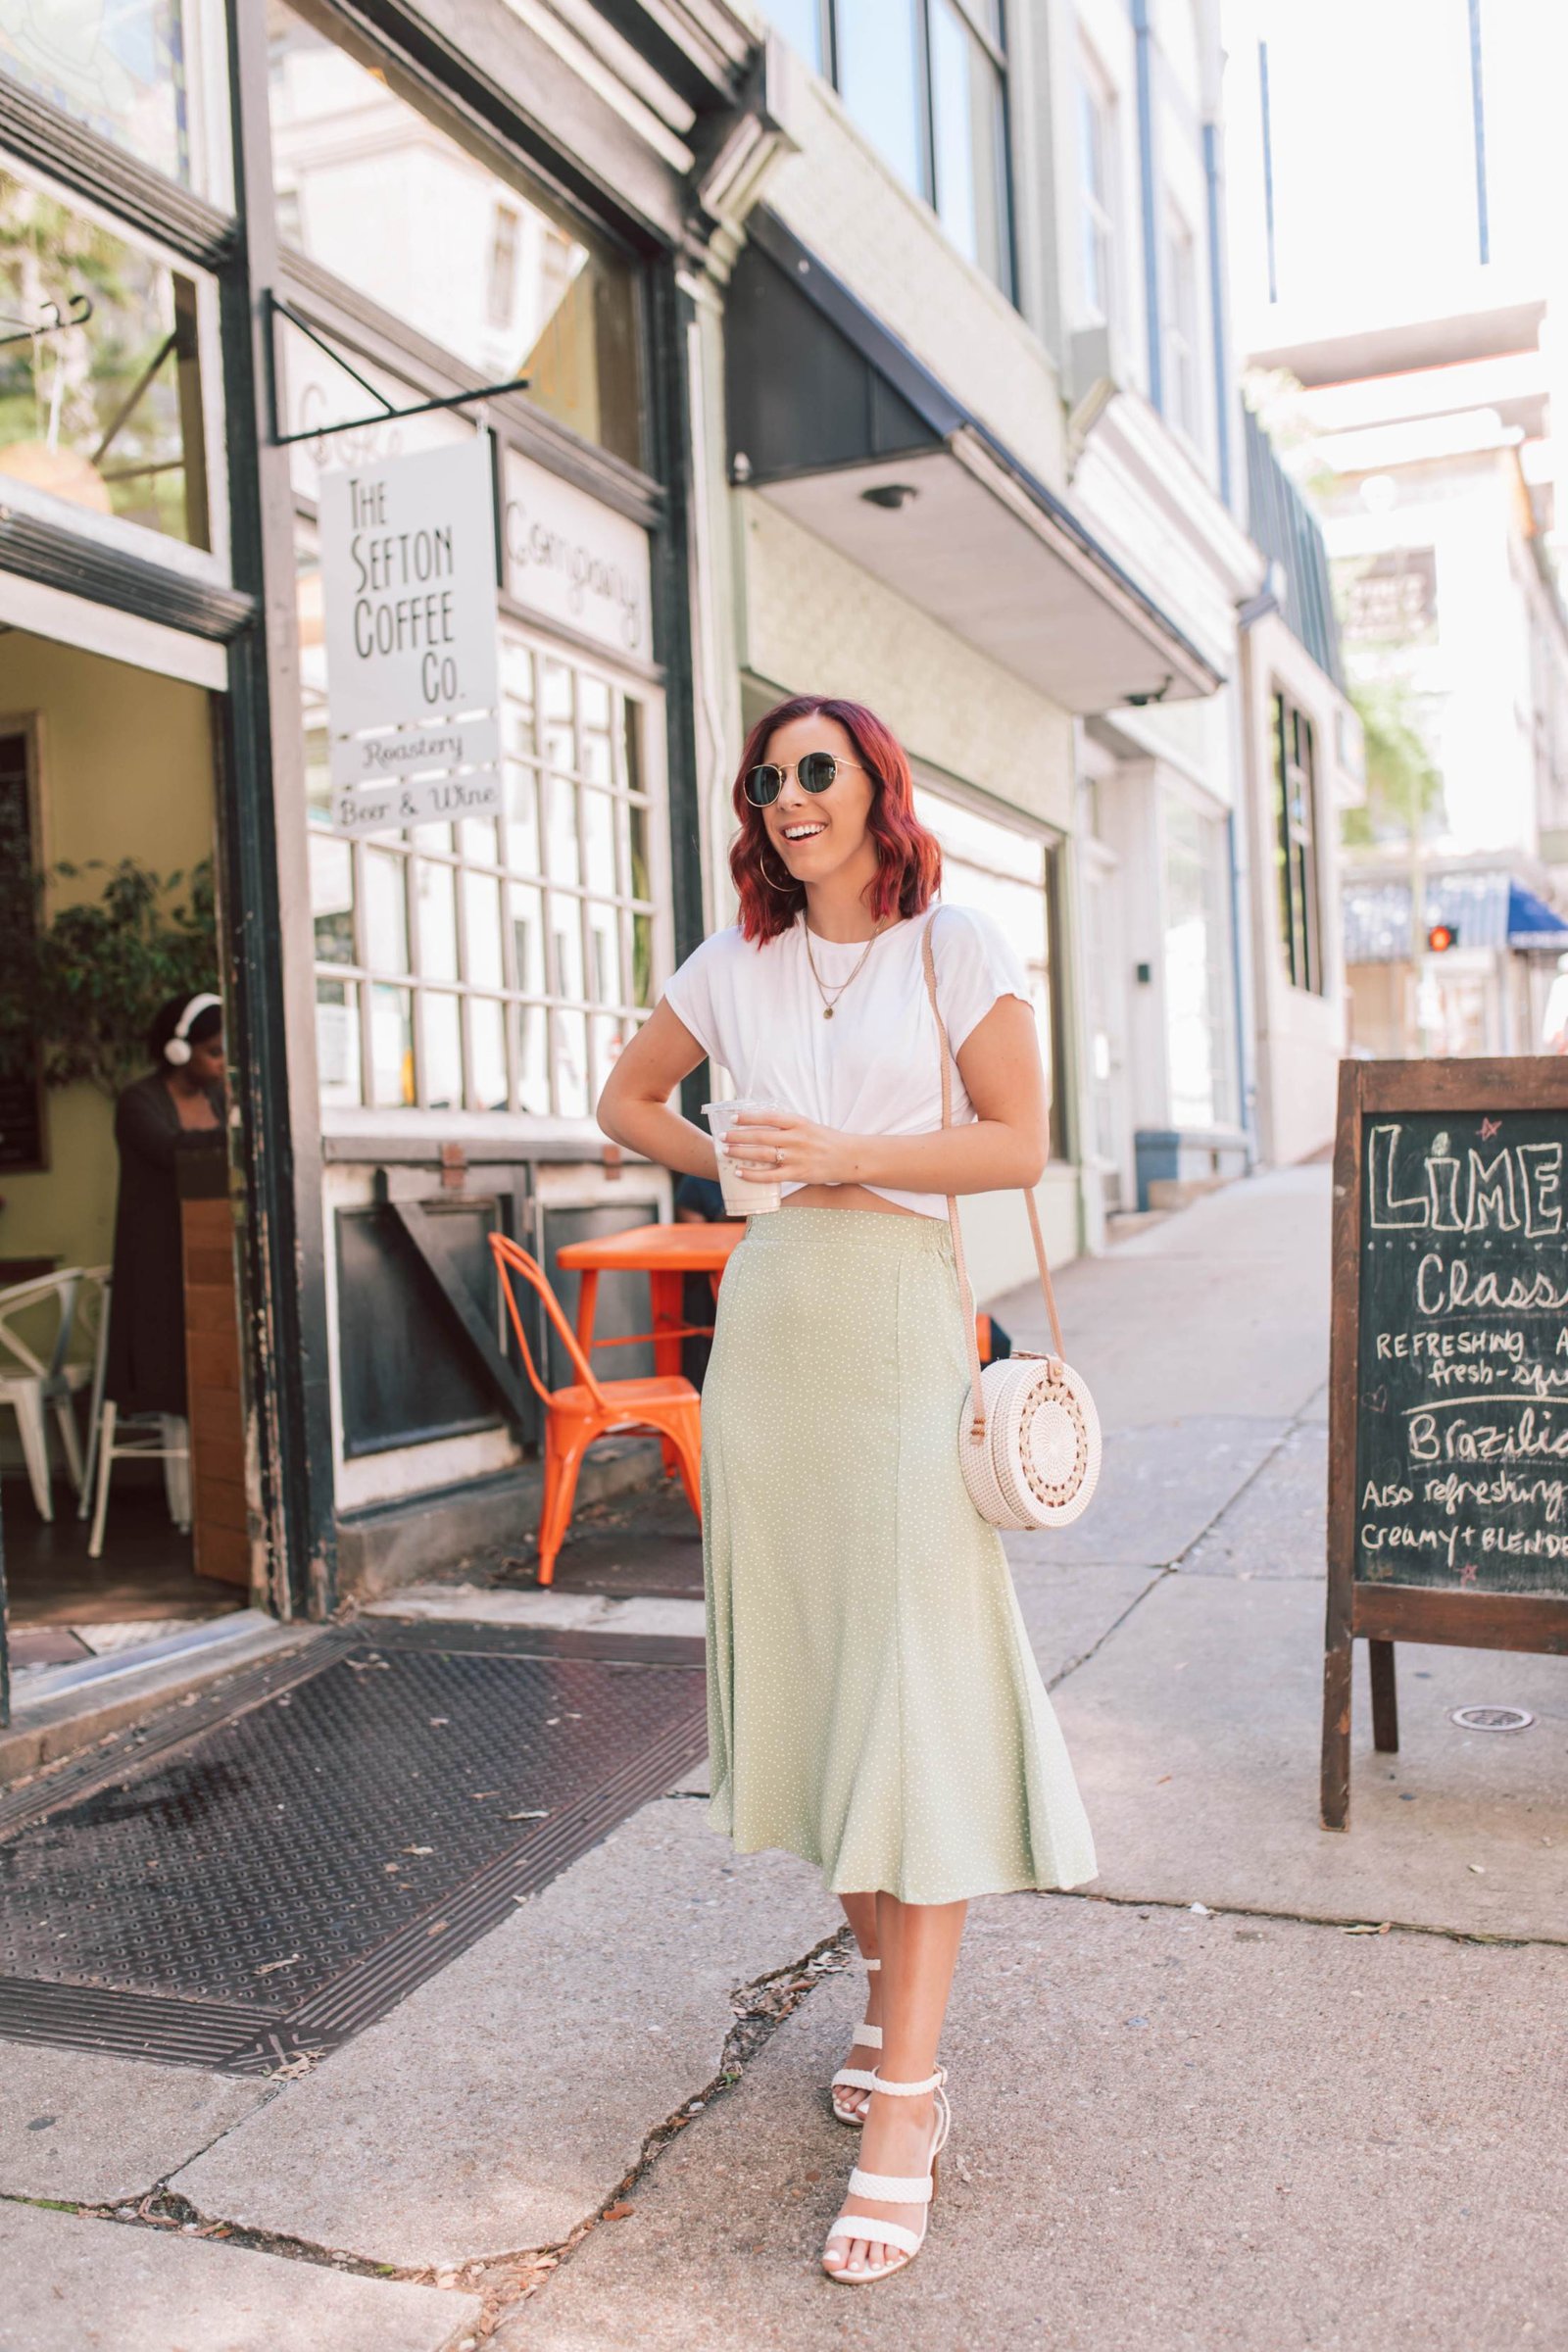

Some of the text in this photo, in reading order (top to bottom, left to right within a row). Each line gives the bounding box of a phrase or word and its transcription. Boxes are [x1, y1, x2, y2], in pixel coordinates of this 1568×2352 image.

[349, 478, 387, 529] THE
[351, 523, 454, 594] SEFTON
[354, 589, 456, 659] COFFEE
[421, 651, 466, 705] CO.
[362, 736, 465, 770] Roastery
[340, 784, 498, 827] Beer & Wine
[1424, 1470, 1568, 1522] refreshing
